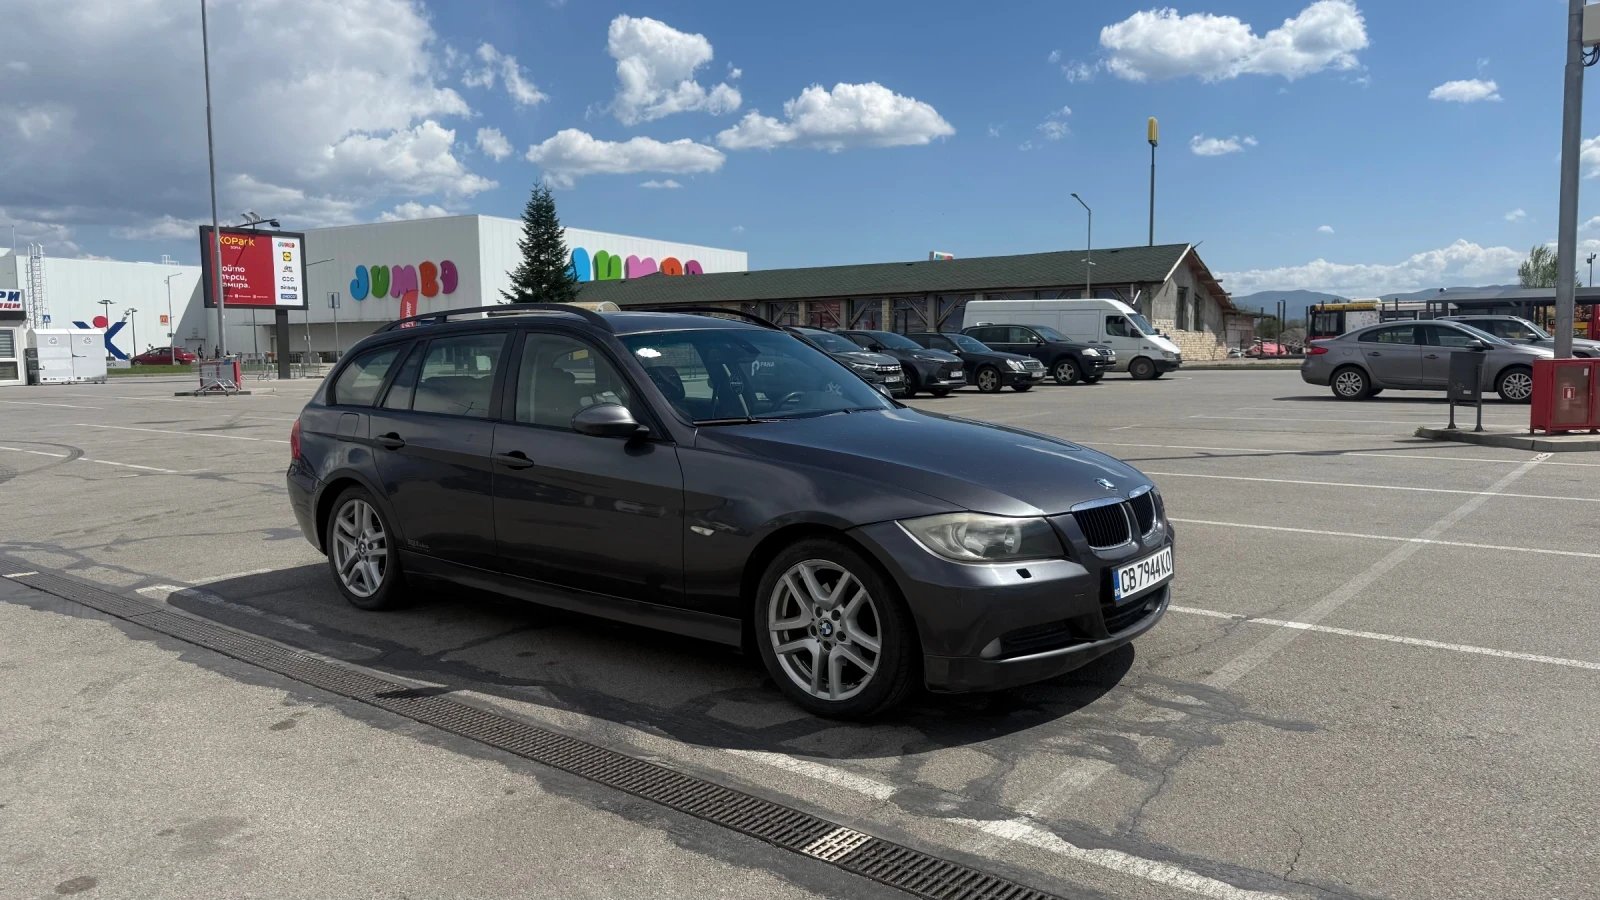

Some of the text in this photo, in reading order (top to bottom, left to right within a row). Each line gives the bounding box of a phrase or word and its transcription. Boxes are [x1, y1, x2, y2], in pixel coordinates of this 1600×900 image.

[219, 236, 254, 246] KOPark
[222, 264, 245, 272] ойто
[350, 260, 458, 301] JUMBO
